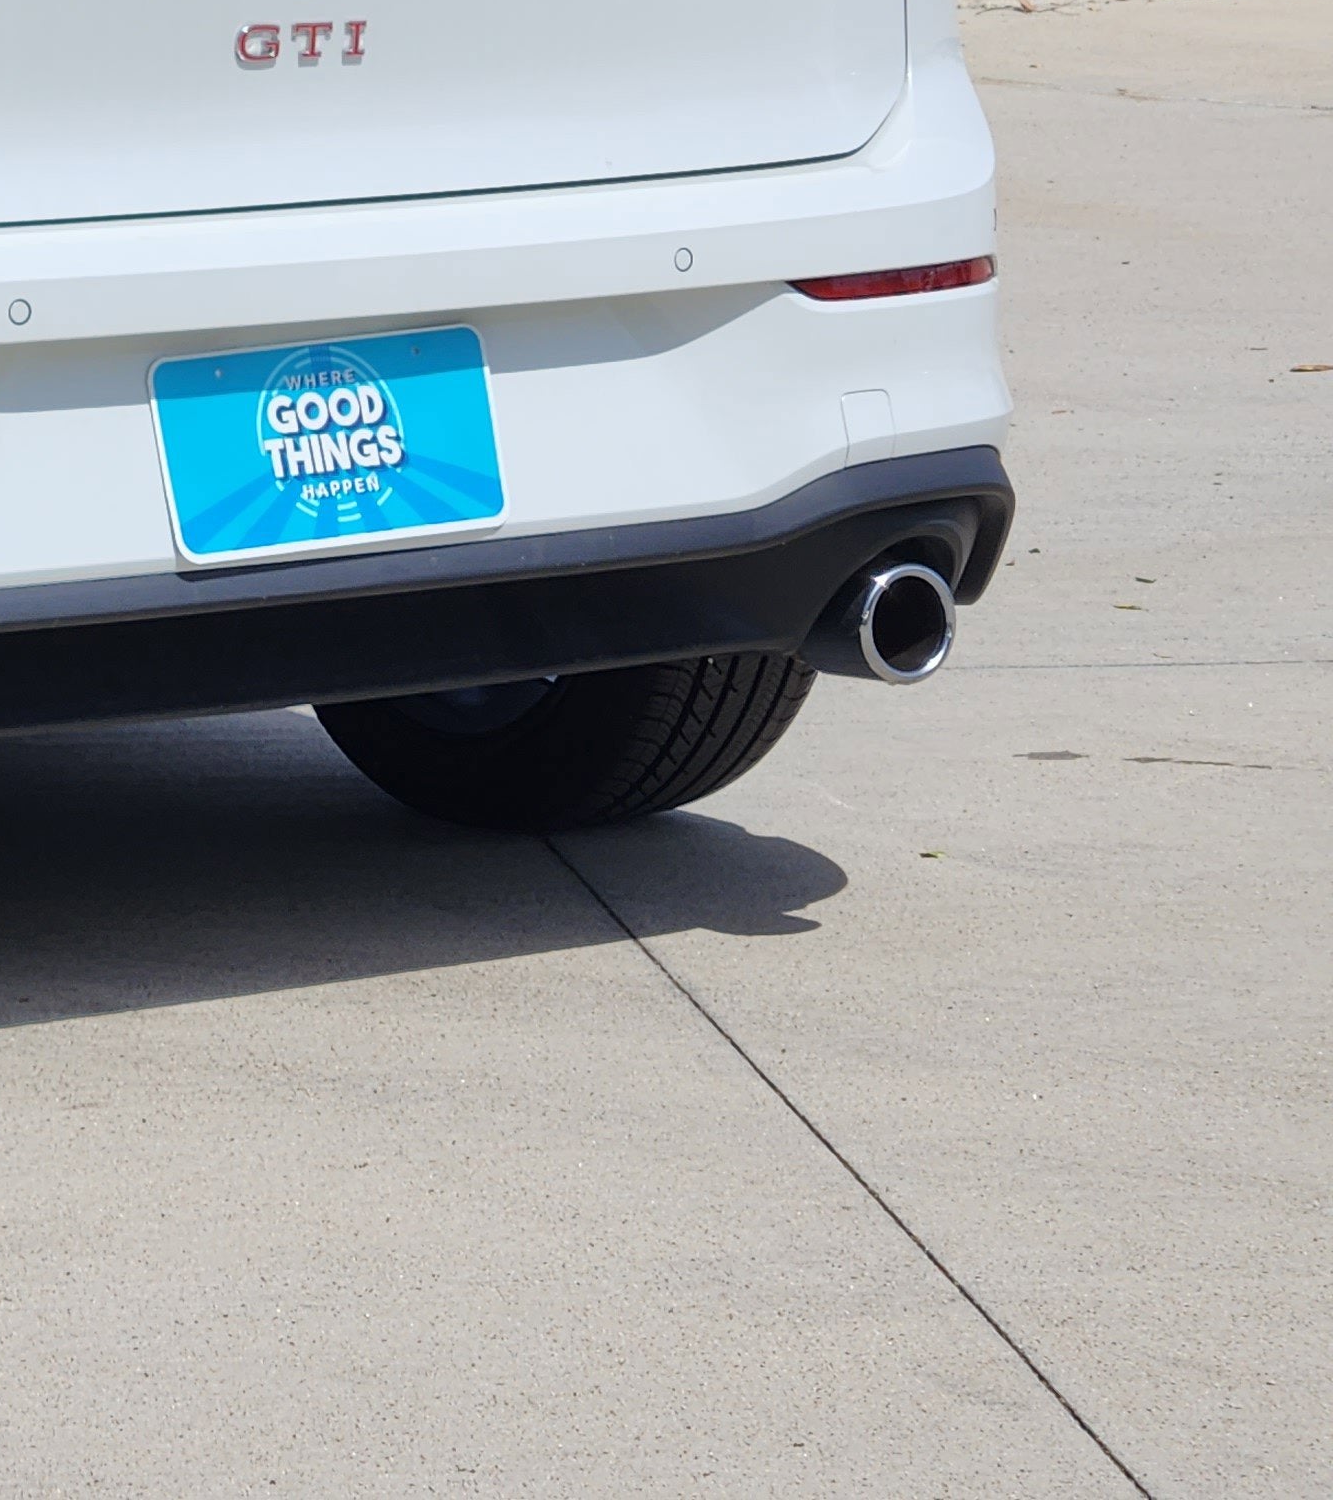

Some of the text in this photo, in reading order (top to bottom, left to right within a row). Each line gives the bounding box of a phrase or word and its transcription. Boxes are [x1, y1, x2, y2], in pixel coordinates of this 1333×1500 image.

[236, 20, 367, 63] GTI
[285, 367, 357, 391] WHERE
[266, 385, 386, 435] GOOD
[263, 424, 405, 479] THINGS
[301, 476, 380, 500] HAPPEN
